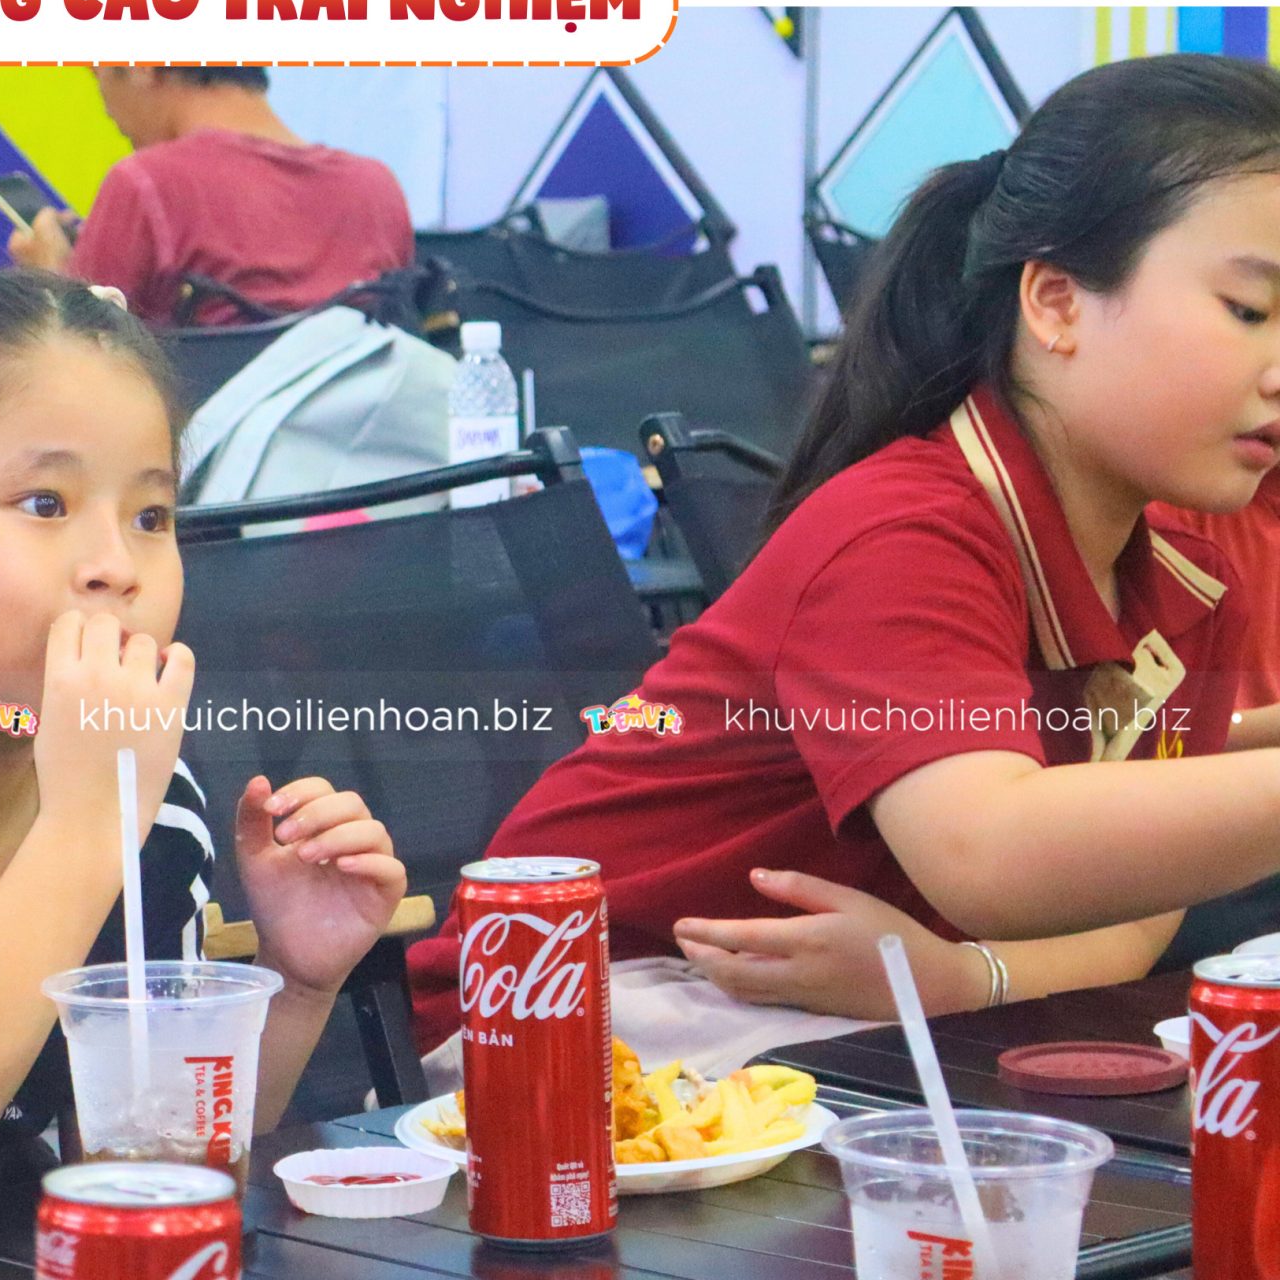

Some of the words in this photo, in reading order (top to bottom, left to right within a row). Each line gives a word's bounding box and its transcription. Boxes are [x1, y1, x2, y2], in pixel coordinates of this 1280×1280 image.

[459, 907, 597, 1020] Cola
[478, 1028, 514, 1047] BẢN
[183, 1055, 234, 1120] KING
[195, 1065, 206, 1086] TEA
[195, 1100, 207, 1137] COFFEE
